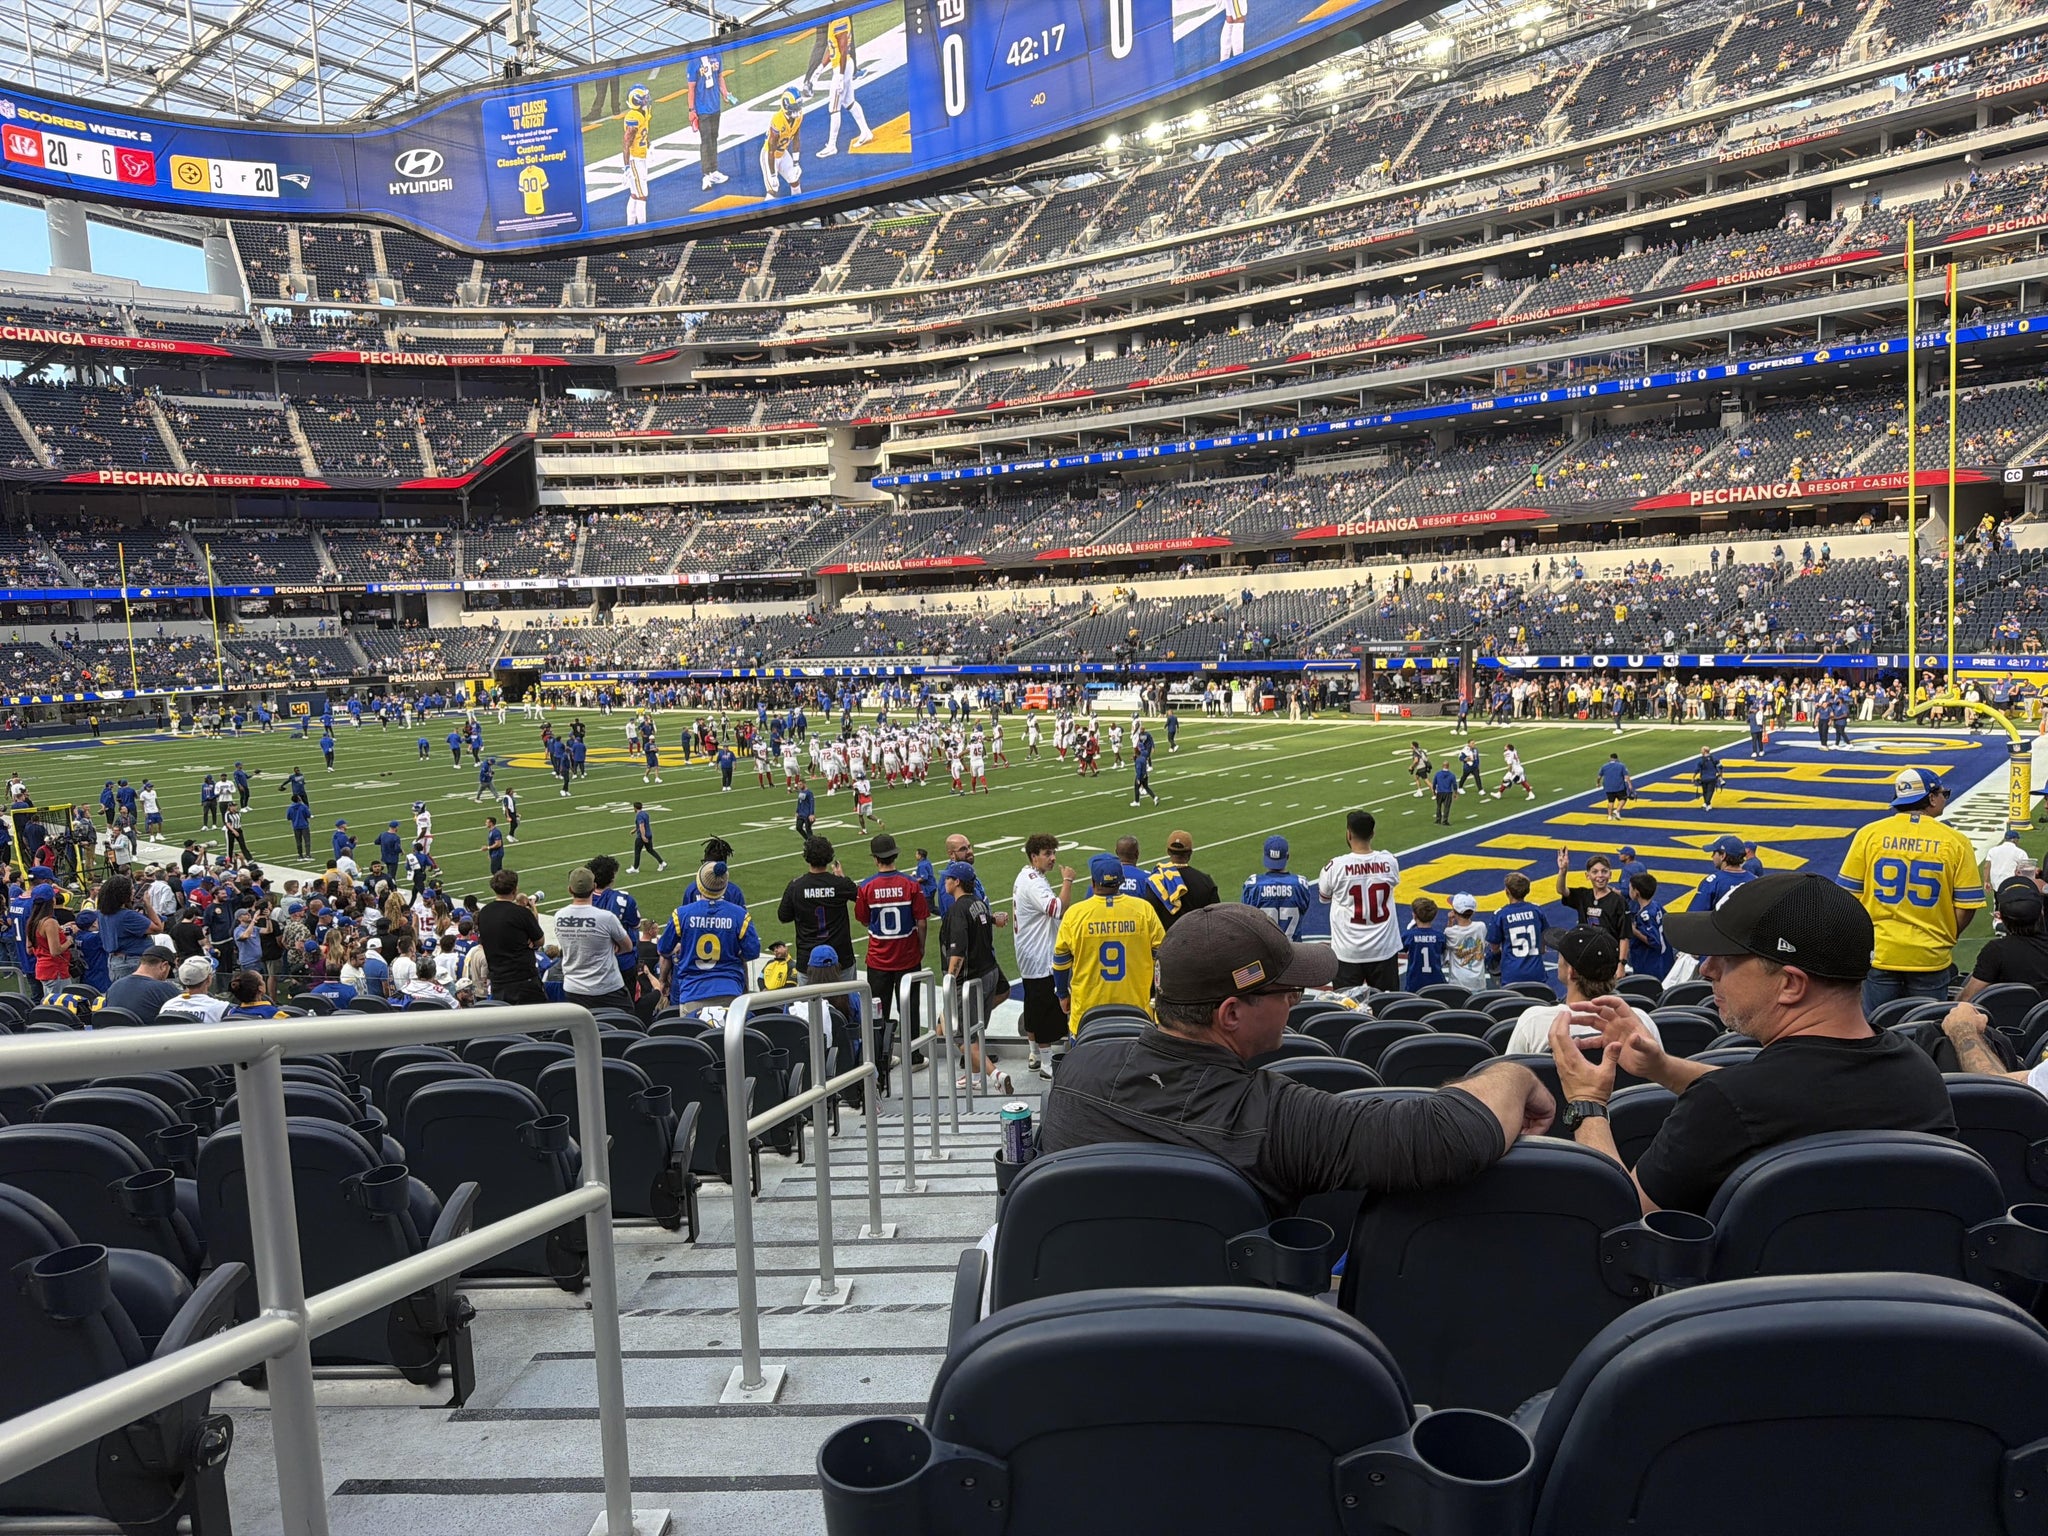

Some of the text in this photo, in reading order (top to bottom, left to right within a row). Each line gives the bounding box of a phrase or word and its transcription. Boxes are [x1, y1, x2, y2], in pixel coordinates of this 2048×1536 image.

[1005, 23, 1066, 67] 42:17
[942, 33, 966, 117] 0
[1976, 72, 2048, 100] PECHANGA
[508, 99, 547, 118] TEXT CLASSIC
[17, 107, 152, 142] SCORES WEEK 2
[513, 113, 545, 130] TO 467267
[516, 145, 545, 155] Custom
[1718, 129, 1839, 164] PECHANGA RESORT CASINO
[47, 139, 111, 175] 20 F 6
[497, 150, 567, 168] Classic Sol Jersey!
[213, 165, 273, 192] 3 F 20
[389, 178, 453, 195] HYUNDAI
[1508, 185, 1608, 213] PECHANGA RESORT CASINO
[1987, 213, 2048, 234] PECHAN
[1328, 229, 1414, 252] PECHANGA RESORT CASINO
[1717, 255, 1842, 286] PECHANGA RESORT CASINO
[1170, 272, 1211, 286] PECHANGA
[1029, 300, 1065, 313] PECHANGA
[1496, 301, 1600, 326] PECHANGA RESORT CASINO
[897, 324, 933, 335] PECHANGA
[1986, 322, 2014, 331] RUSH
[1986, 320, 2029, 338] YDS 0
[90, 336, 131, 348] RESORT
[136, 341, 175, 350] CASINO
[759, 338, 797, 348] PECHANGA
[1915, 333, 1941, 342] PASS
[1915, 339, 1934, 349] YDS
[1310, 337, 1399, 359] PECHANGA RESORT CASINO
[1845, 342, 1889, 355] PLAYS 0
[360, 351, 522, 366] PECHANGA RESORT CASINO
[1748, 355, 1804, 371] OFFENSE
[1149, 373, 1190, 385] PECHANGA
[1005, 396, 1042, 407] PECHANGA
[1472, 400, 1494, 411] RAMS
[870, 414, 907, 423] PECHANGA
[1354, 418, 1371, 427] 42:17
[728, 425, 767, 434] PECHANGA
[1014, 462, 1045, 471] OFFENSE
[98, 470, 300, 487] PECHANGA RESORT CASINO
[2005, 469, 2023, 482] CC
[1691, 476, 1911, 505] PECHANGA RESORT CASINO
[1337, 512, 1497, 536] PECHANGA RESORT CASINO
[1069, 539, 1193, 558] PECHANGA RESORT CASINO
[847, 558, 953, 573] PECHANGA RESORT CASINO
[275, 586, 324, 594] PECHANGA
[381, 583, 421, 591] SCORES
[511, 656, 545, 667] RAMS
[1375, 654, 1715, 669] RAM HOUSE
[1972, 658, 2031, 667] PRE 42:17
[389, 672, 443, 683] PECHANGA
[733, 667, 791, 677] RAMS
[228, 683, 247, 691] PLAY
[248, 682, 267, 690] YOUR
[268, 681, 298, 689] PERFT
[300, 678, 350, 688] COBINATION
[10, 692, 84, 704] RAMS
[1375, 704, 1399, 714] ESPN
[2012, 766, 2022, 817] RAMS
[1882, 835, 1940, 854] GARRETT
[1345, 861, 1391, 876] MANNING
[1873, 857, 1945, 907] 95
[804, 887, 835, 899] NABERS
[874, 886, 904, 899] BURNS
[1261, 885, 1293, 897] JACOBS
[1349, 882, 1391, 926] 10
[689, 915, 733, 930] STAFFORD
[814, 906, 830, 938] 1
[880, 906, 902, 936] 0
[1506, 910, 1534, 923] CARTER
[13, 917, 22, 942] 1
[1087, 920, 1137, 935] STAFFORD
[1414, 935, 1437, 943] NABERS
[1509, 924, 1537, 958] 51
[695, 933, 722, 970] 9
[1099, 940, 1126, 982] 9
[1420, 946, 1432, 973] 1
